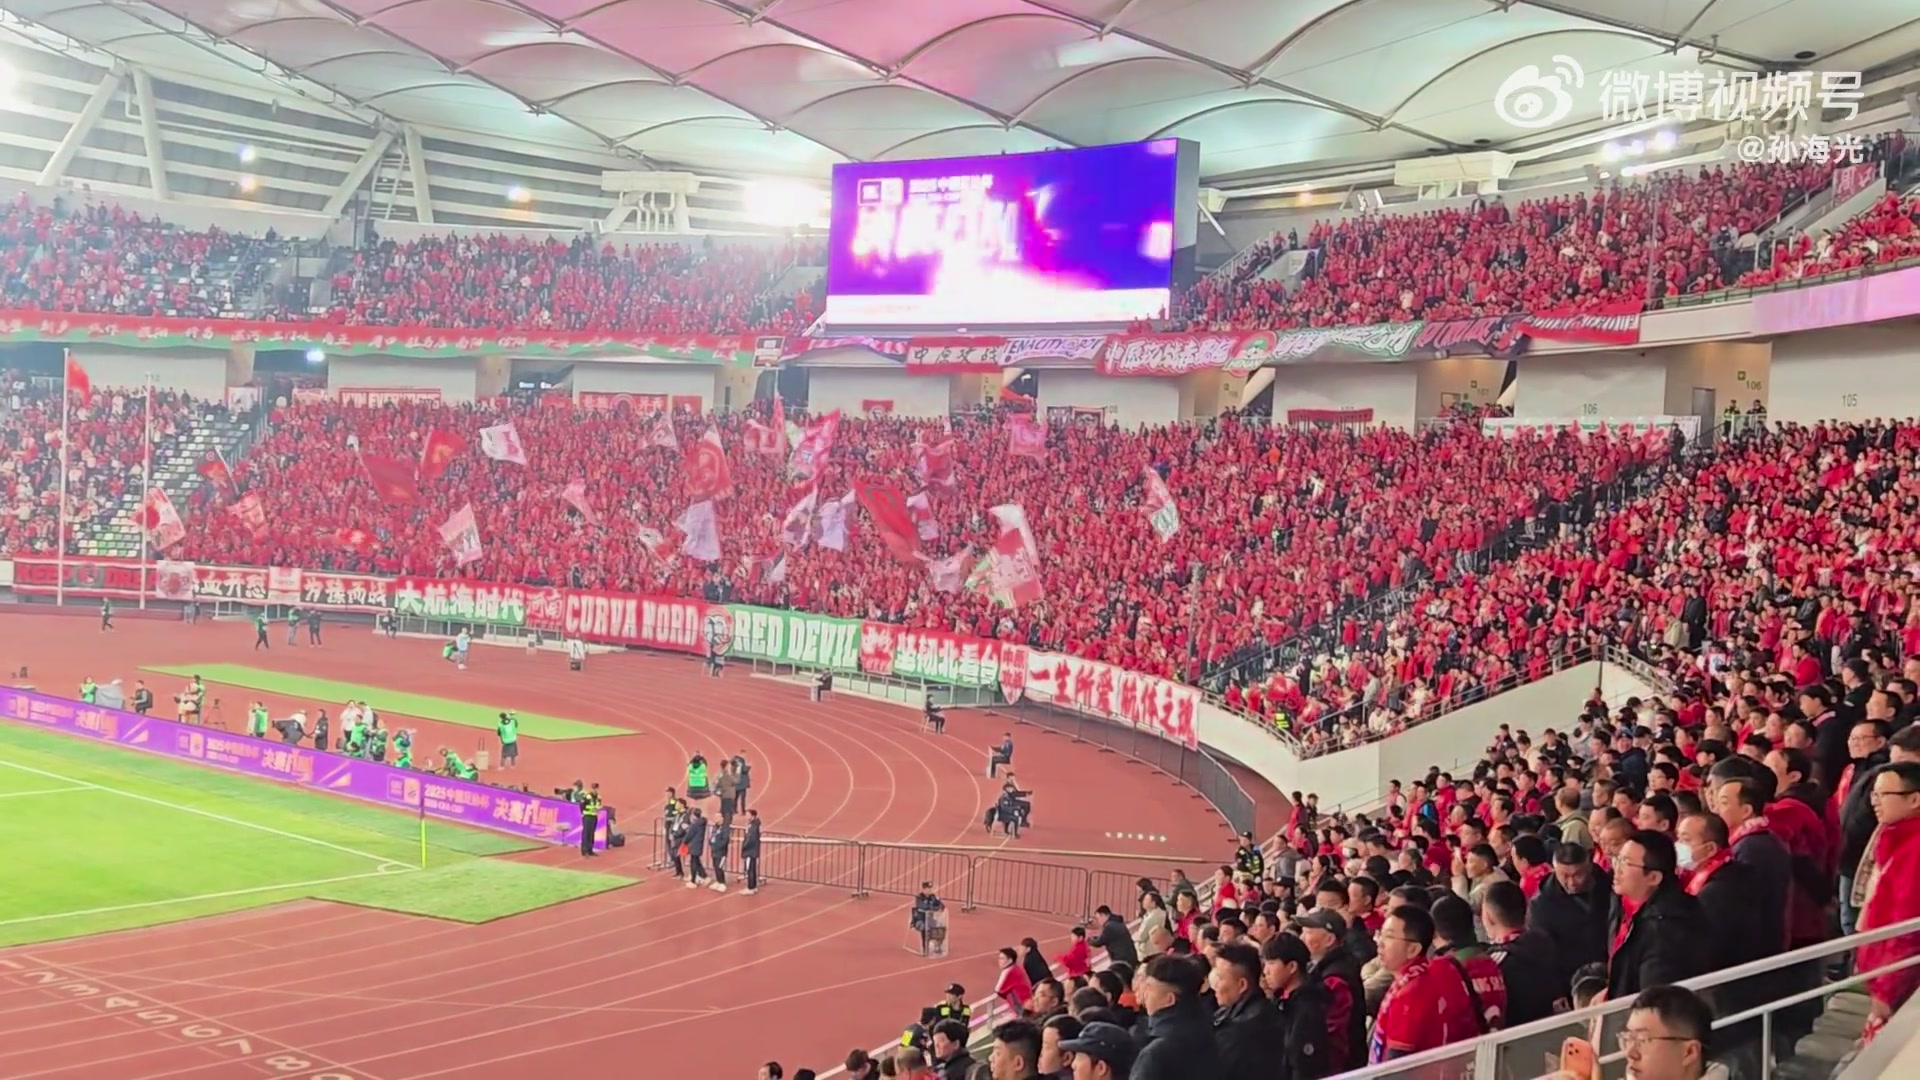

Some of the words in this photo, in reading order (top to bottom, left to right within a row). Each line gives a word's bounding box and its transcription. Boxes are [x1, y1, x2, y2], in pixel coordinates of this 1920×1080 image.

[1004, 338, 1062, 354] TENACITY
[1746, 380, 1762, 391] 106
[1842, 393, 1858, 407] 105
[1583, 403, 1598, 415] 106
[399, 580, 525, 623] 大航海时代
[566, 594, 637, 639] CURVA
[641, 599, 700, 647] NORD
[733, 609, 784, 658] RED
[787, 616, 858, 669] DEVIL
[24, 971, 67, 985] 2
[59, 981, 101, 997] 3
[105, 996, 139, 1009] 4
[136, 1009, 179, 1025] 5
[181, 1023, 222, 1039] 6
[217, 1038, 253, 1054] 7
[265, 1055, 312, 1071] 8
